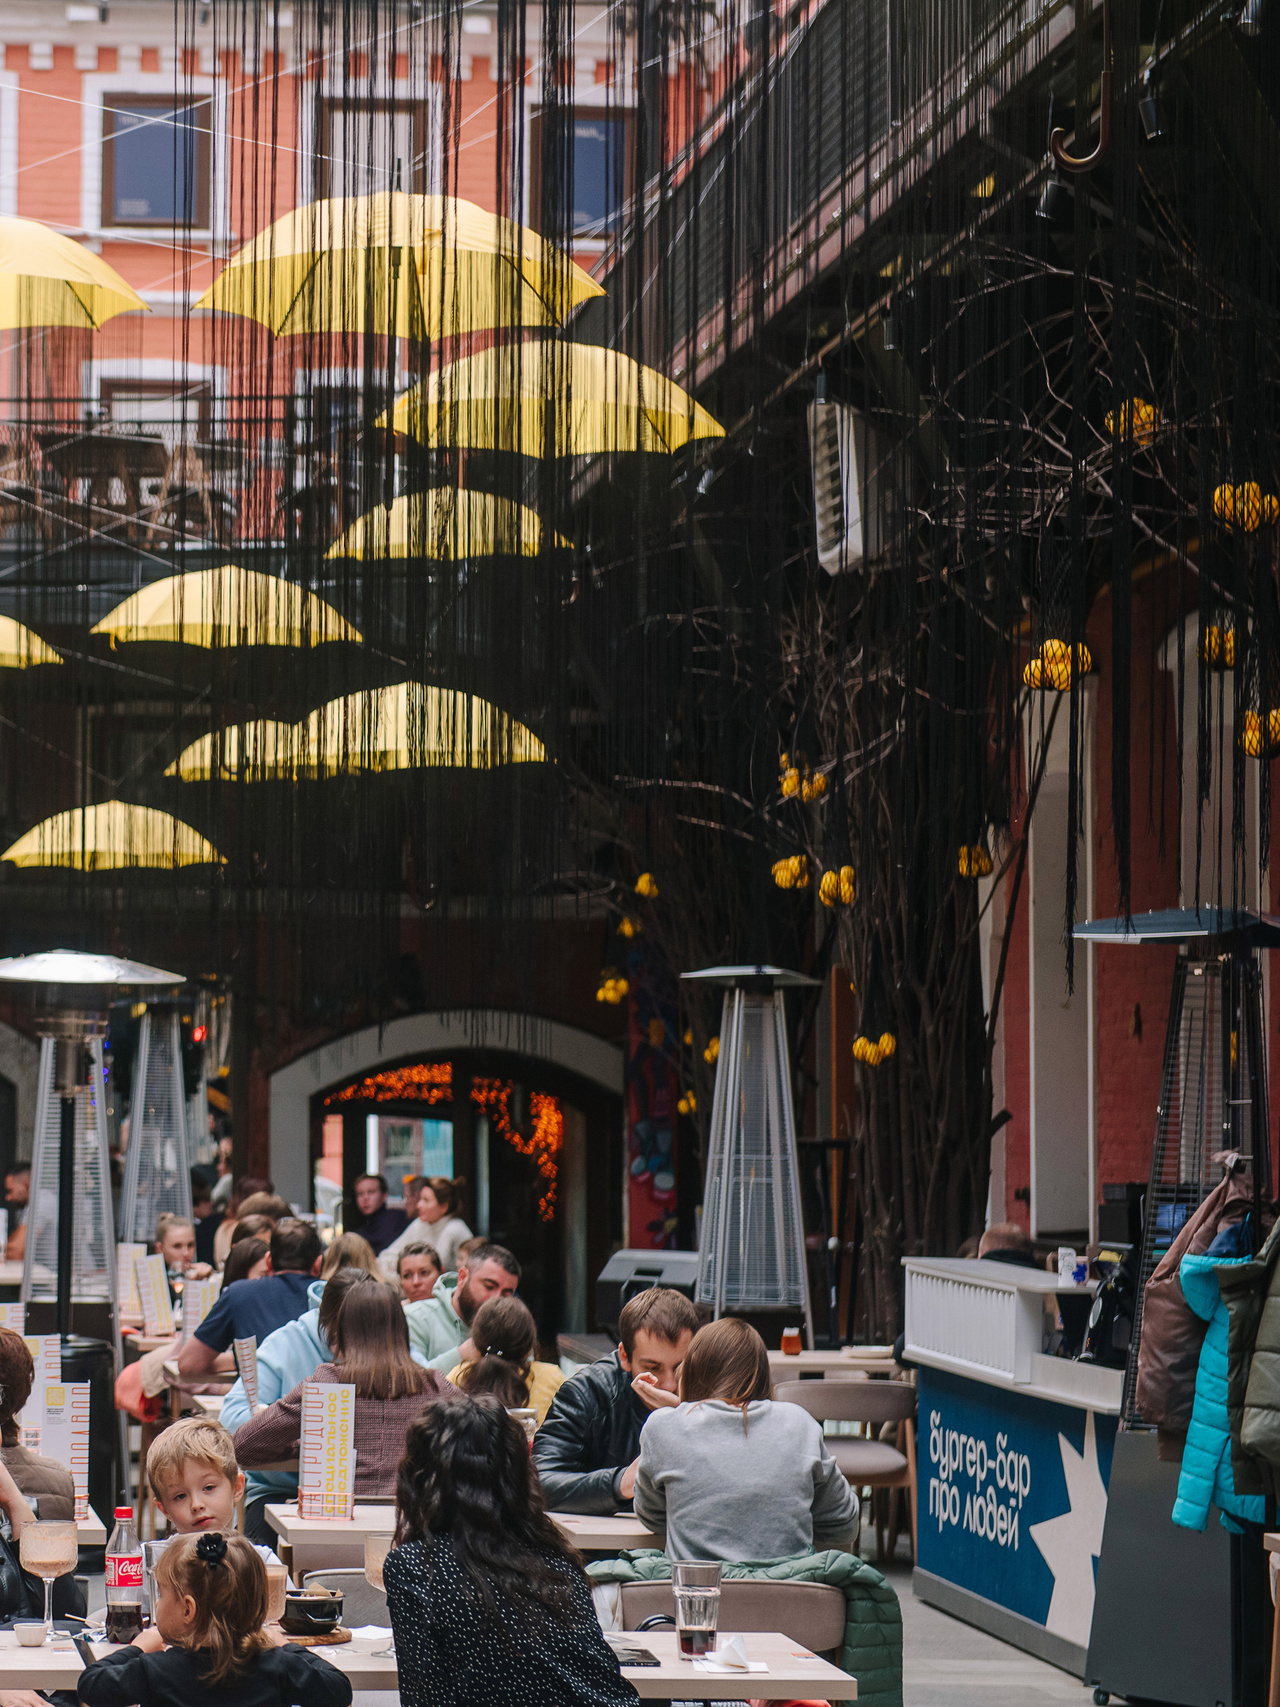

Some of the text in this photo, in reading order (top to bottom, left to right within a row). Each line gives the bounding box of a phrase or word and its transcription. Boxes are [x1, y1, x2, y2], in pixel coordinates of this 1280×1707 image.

[929, 1409, 1031, 1509] бургер-бар
[929, 1477, 1019, 1551] про людей
